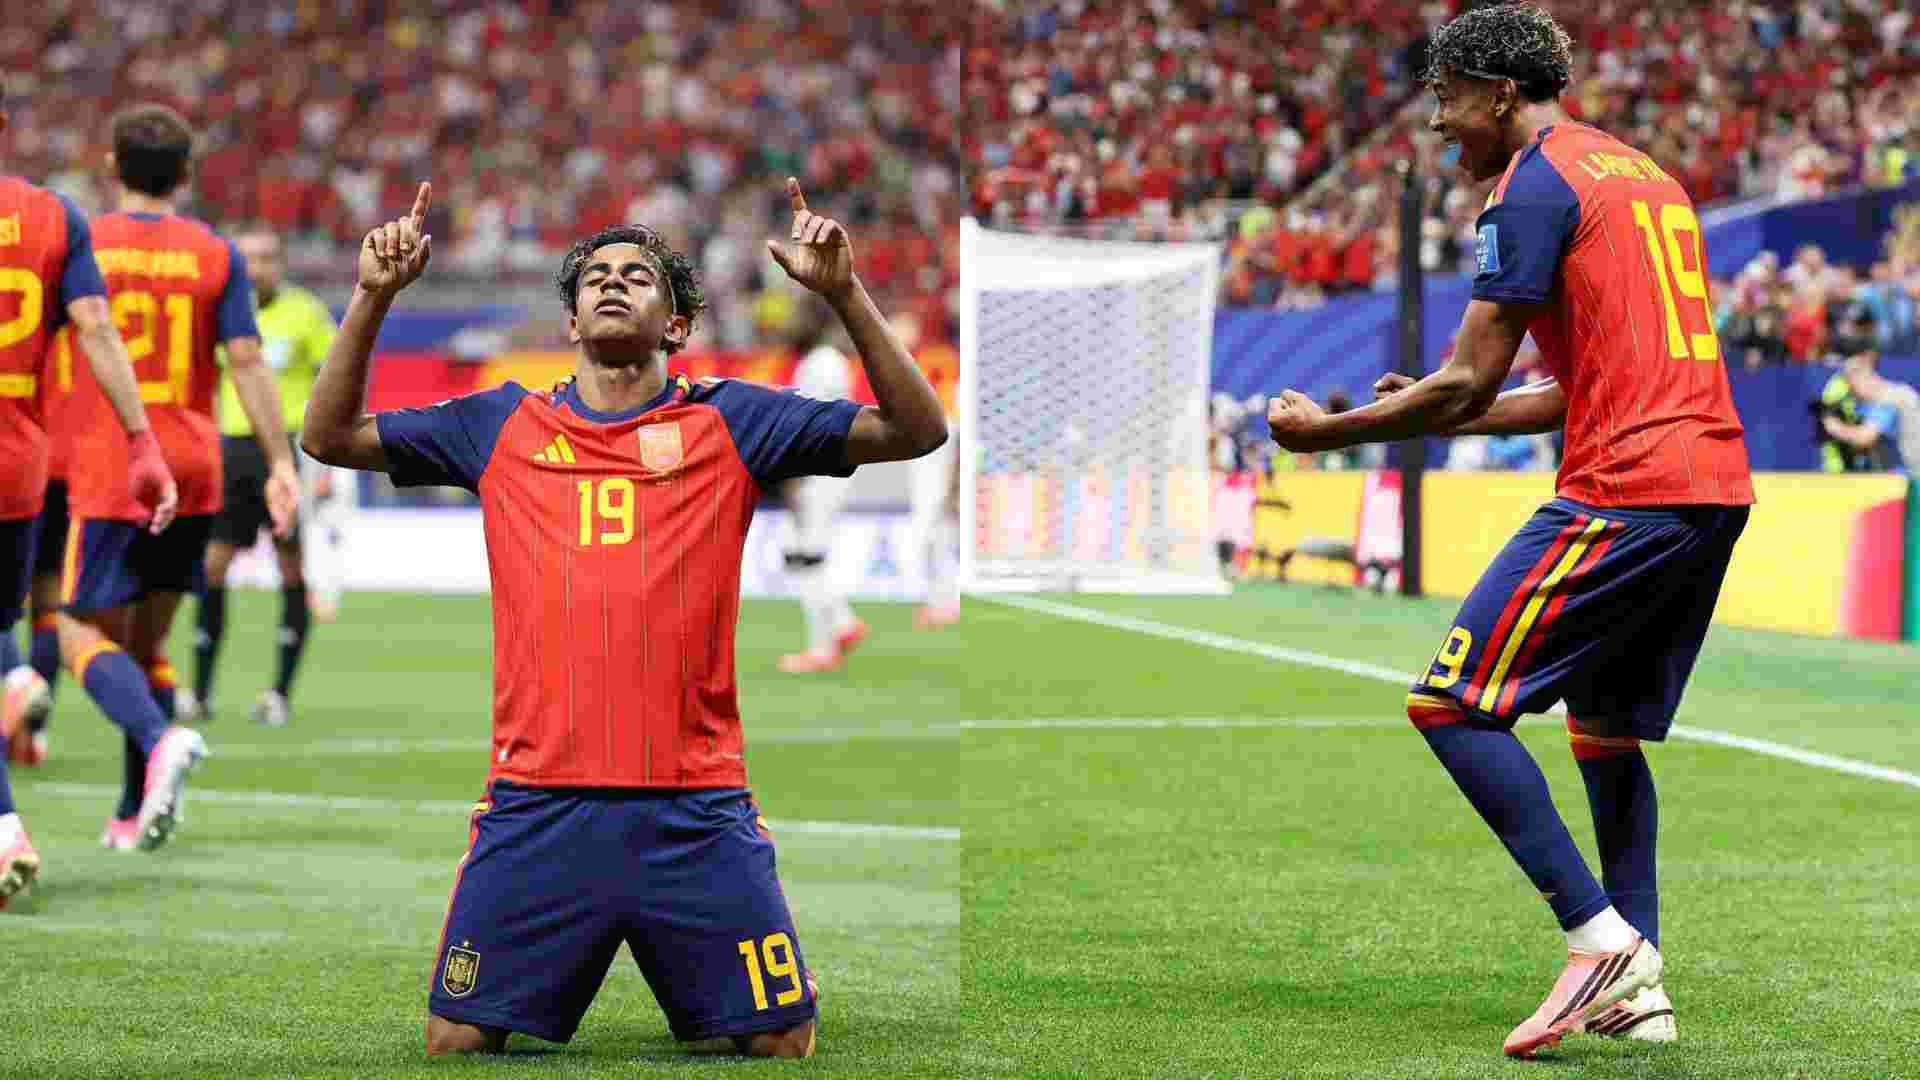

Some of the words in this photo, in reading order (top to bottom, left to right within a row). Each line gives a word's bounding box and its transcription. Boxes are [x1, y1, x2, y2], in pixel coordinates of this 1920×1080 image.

[1631, 200, 1718, 360] 19
[111, 288, 194, 406] 21
[577, 478, 635, 545] 19
[1415, 626, 1473, 688] 19
[738, 932, 803, 1012] 19
